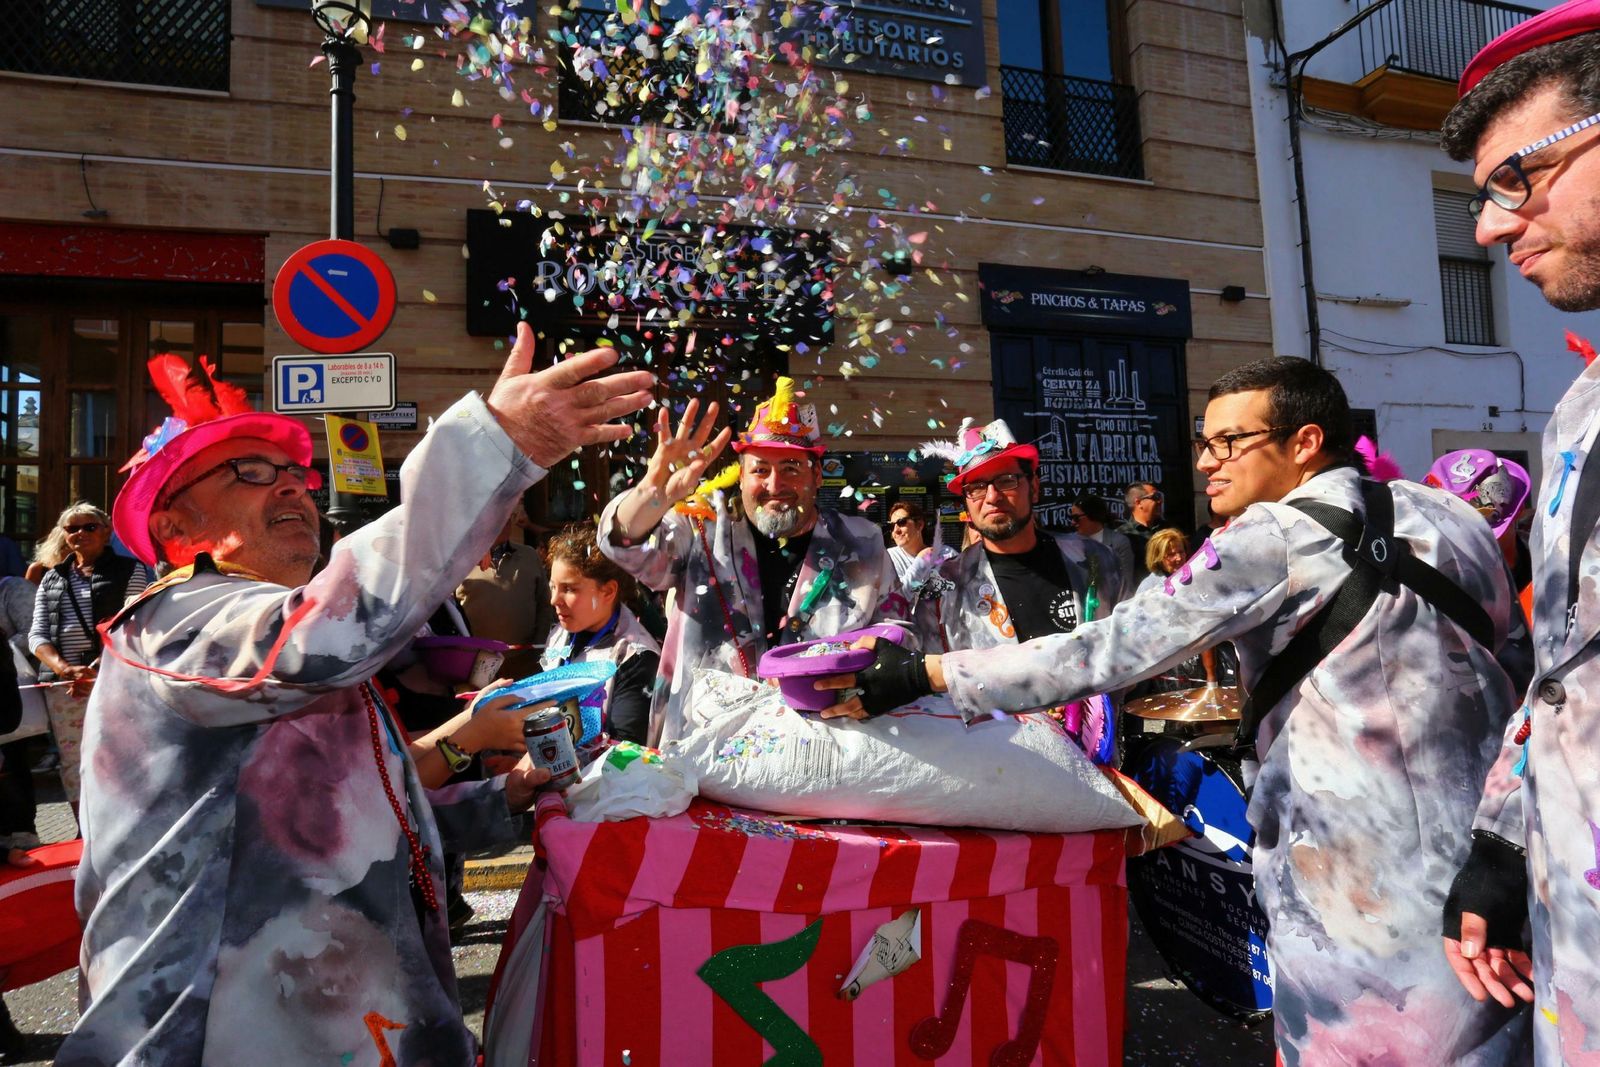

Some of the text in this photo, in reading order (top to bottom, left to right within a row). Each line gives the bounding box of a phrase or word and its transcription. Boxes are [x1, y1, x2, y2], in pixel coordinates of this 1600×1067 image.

[818, 15, 945, 46] AESORES
[1031, 292, 1146, 313] PINCHOS & TAPAS
[328, 363, 355, 371] Laborables
[332, 376, 363, 384] EXCEPTO
[376, 375, 382, 383] D
[1043, 379, 1101, 390] CERVEZA
[552, 761, 571, 772] BEER
